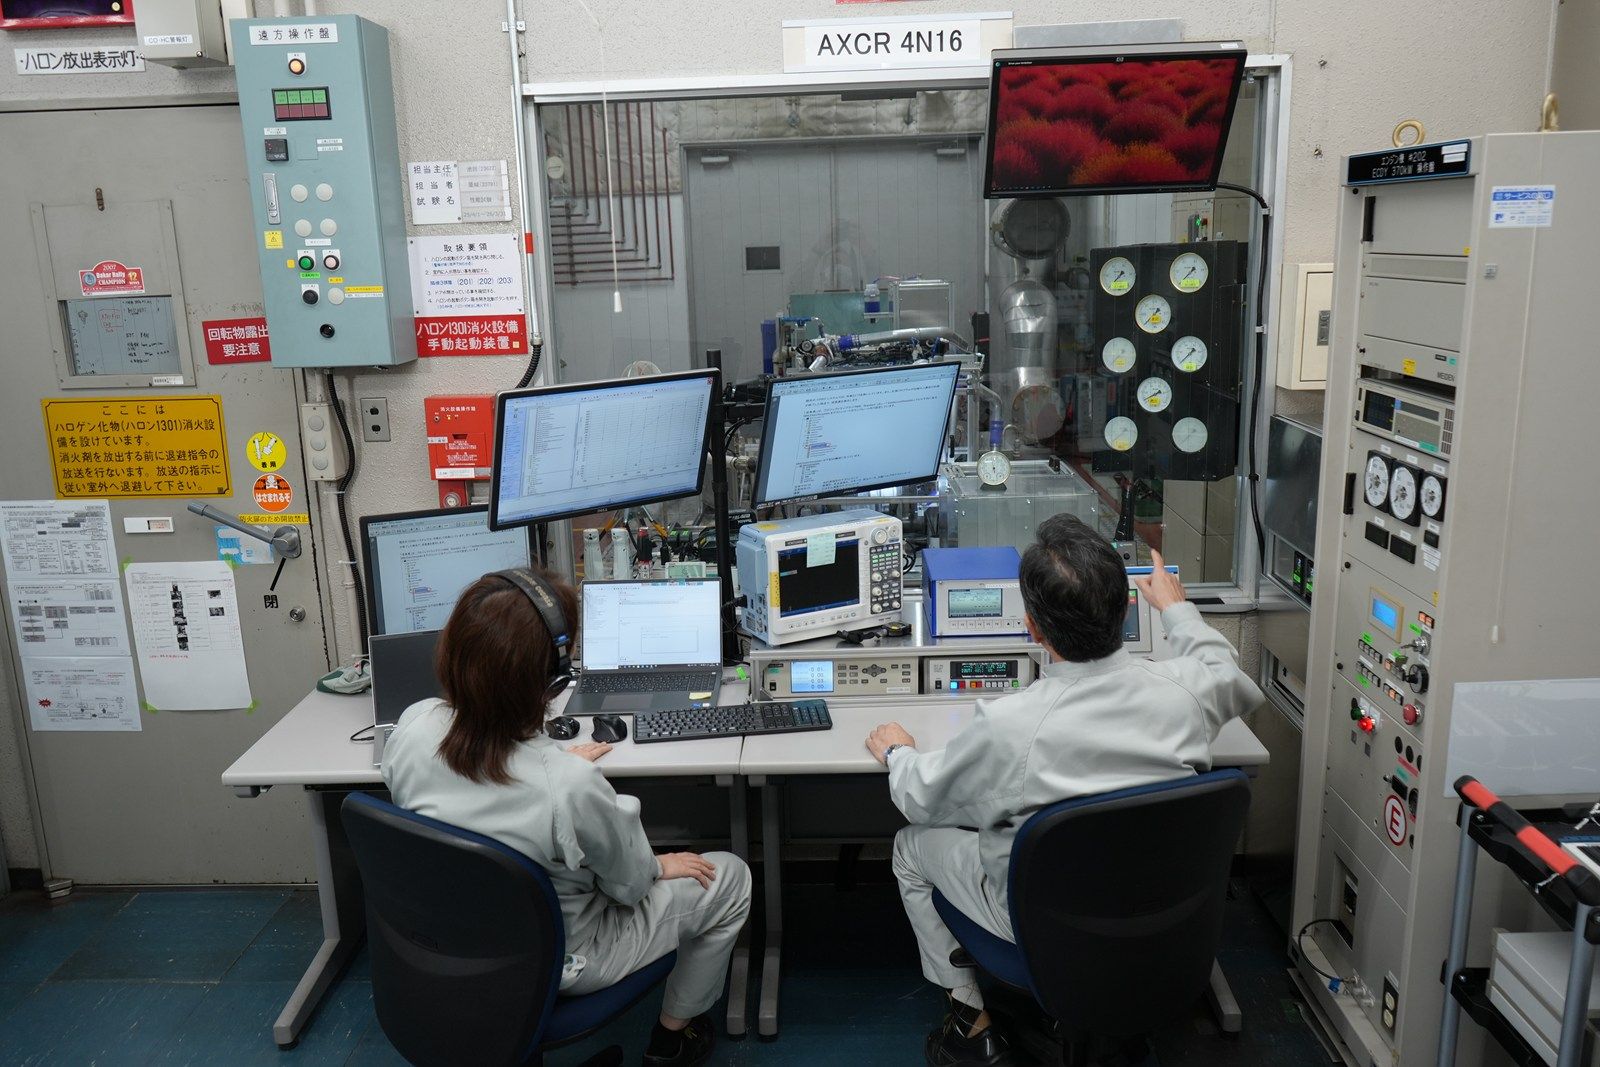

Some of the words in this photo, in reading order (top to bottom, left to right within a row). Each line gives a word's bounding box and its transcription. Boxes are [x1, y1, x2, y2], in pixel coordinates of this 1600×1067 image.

[259, 28, 329, 41] 遠方操作盤
[817, 33, 890, 56] AXCR
[901, 30, 962, 53] 4N16
[25, 51, 136, 70] ハロン放出表示灯
[413, 165, 451, 174] 担当主任
[416, 181, 453, 190] 担当者
[417, 196, 455, 206] 試験名
[444, 243, 488, 252] 取扱要領
[208, 325, 269, 341] 回転物露出
[417, 320, 519, 336] ハロン1301消火設備
[223, 342, 261, 357] 要注意
[428, 337, 510, 351] 手動起動装置
[102, 405, 165, 416] ここには
[55, 419, 215, 433] ハロゲン化物(ハロン1301)消火設
[56, 435, 151, 448] 備を設けています。
[59, 448, 218, 464] 消火剤を放出する前に退避指令の
[64, 480, 202, 493] 従い室外へ退避して下さい。
[255, 492, 290, 503] はさまれるぞ
[264, 594, 278, 609] 閉
[1390, 804, 1401, 838] E
